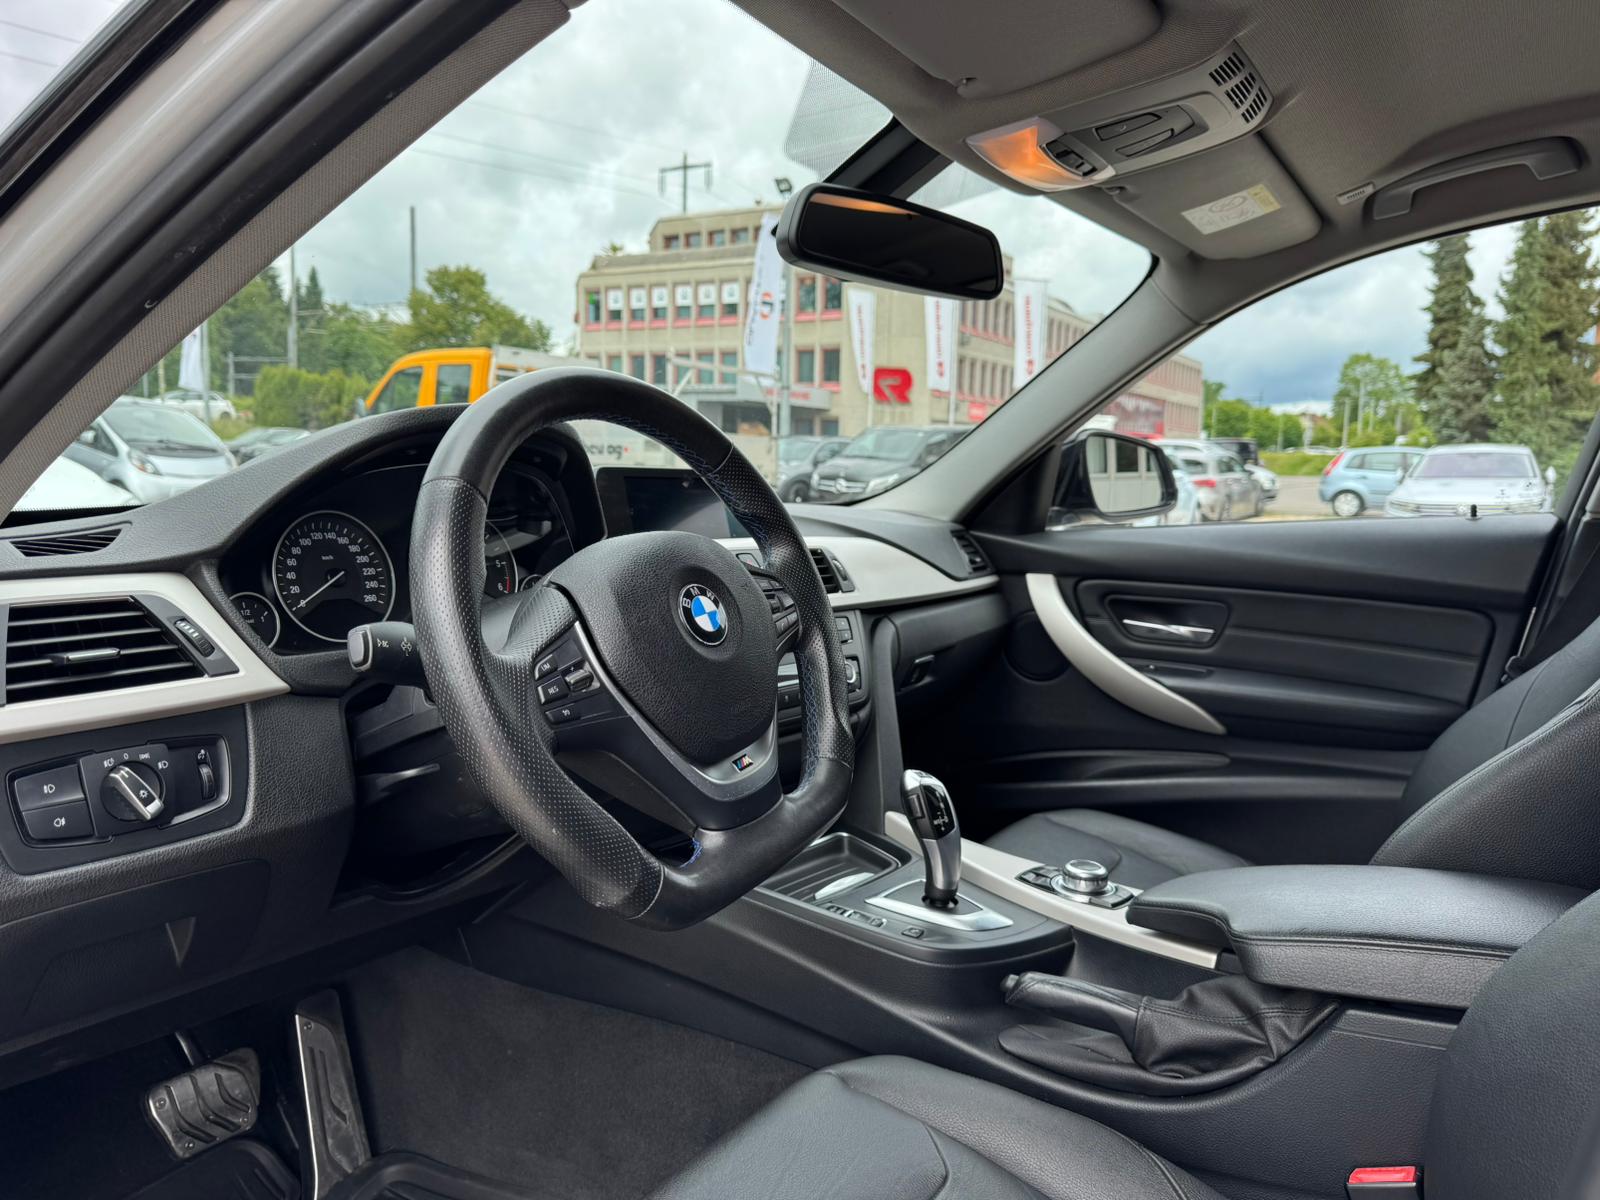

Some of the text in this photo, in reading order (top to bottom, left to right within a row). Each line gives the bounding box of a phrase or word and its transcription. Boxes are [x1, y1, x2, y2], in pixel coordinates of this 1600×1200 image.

[310, 532, 323, 540] 120
[323, 532, 337, 540] 140
[299, 538, 312, 546] 100
[336, 537, 350, 545] 160
[291, 546, 302, 555] 80
[348, 544, 361, 553] 180
[286, 558, 297, 566] 60
[355, 555, 370, 563] 200
[495, 559, 501, 568] 5
[285, 571, 297, 580] 40
[362, 567, 377, 576] 220
[364, 580, 379, 589] 240
[497, 582, 504, 591] 6
[289, 585, 300, 594] 20
[363, 594, 378, 603] 260
[682, 586, 716, 609] BMW
